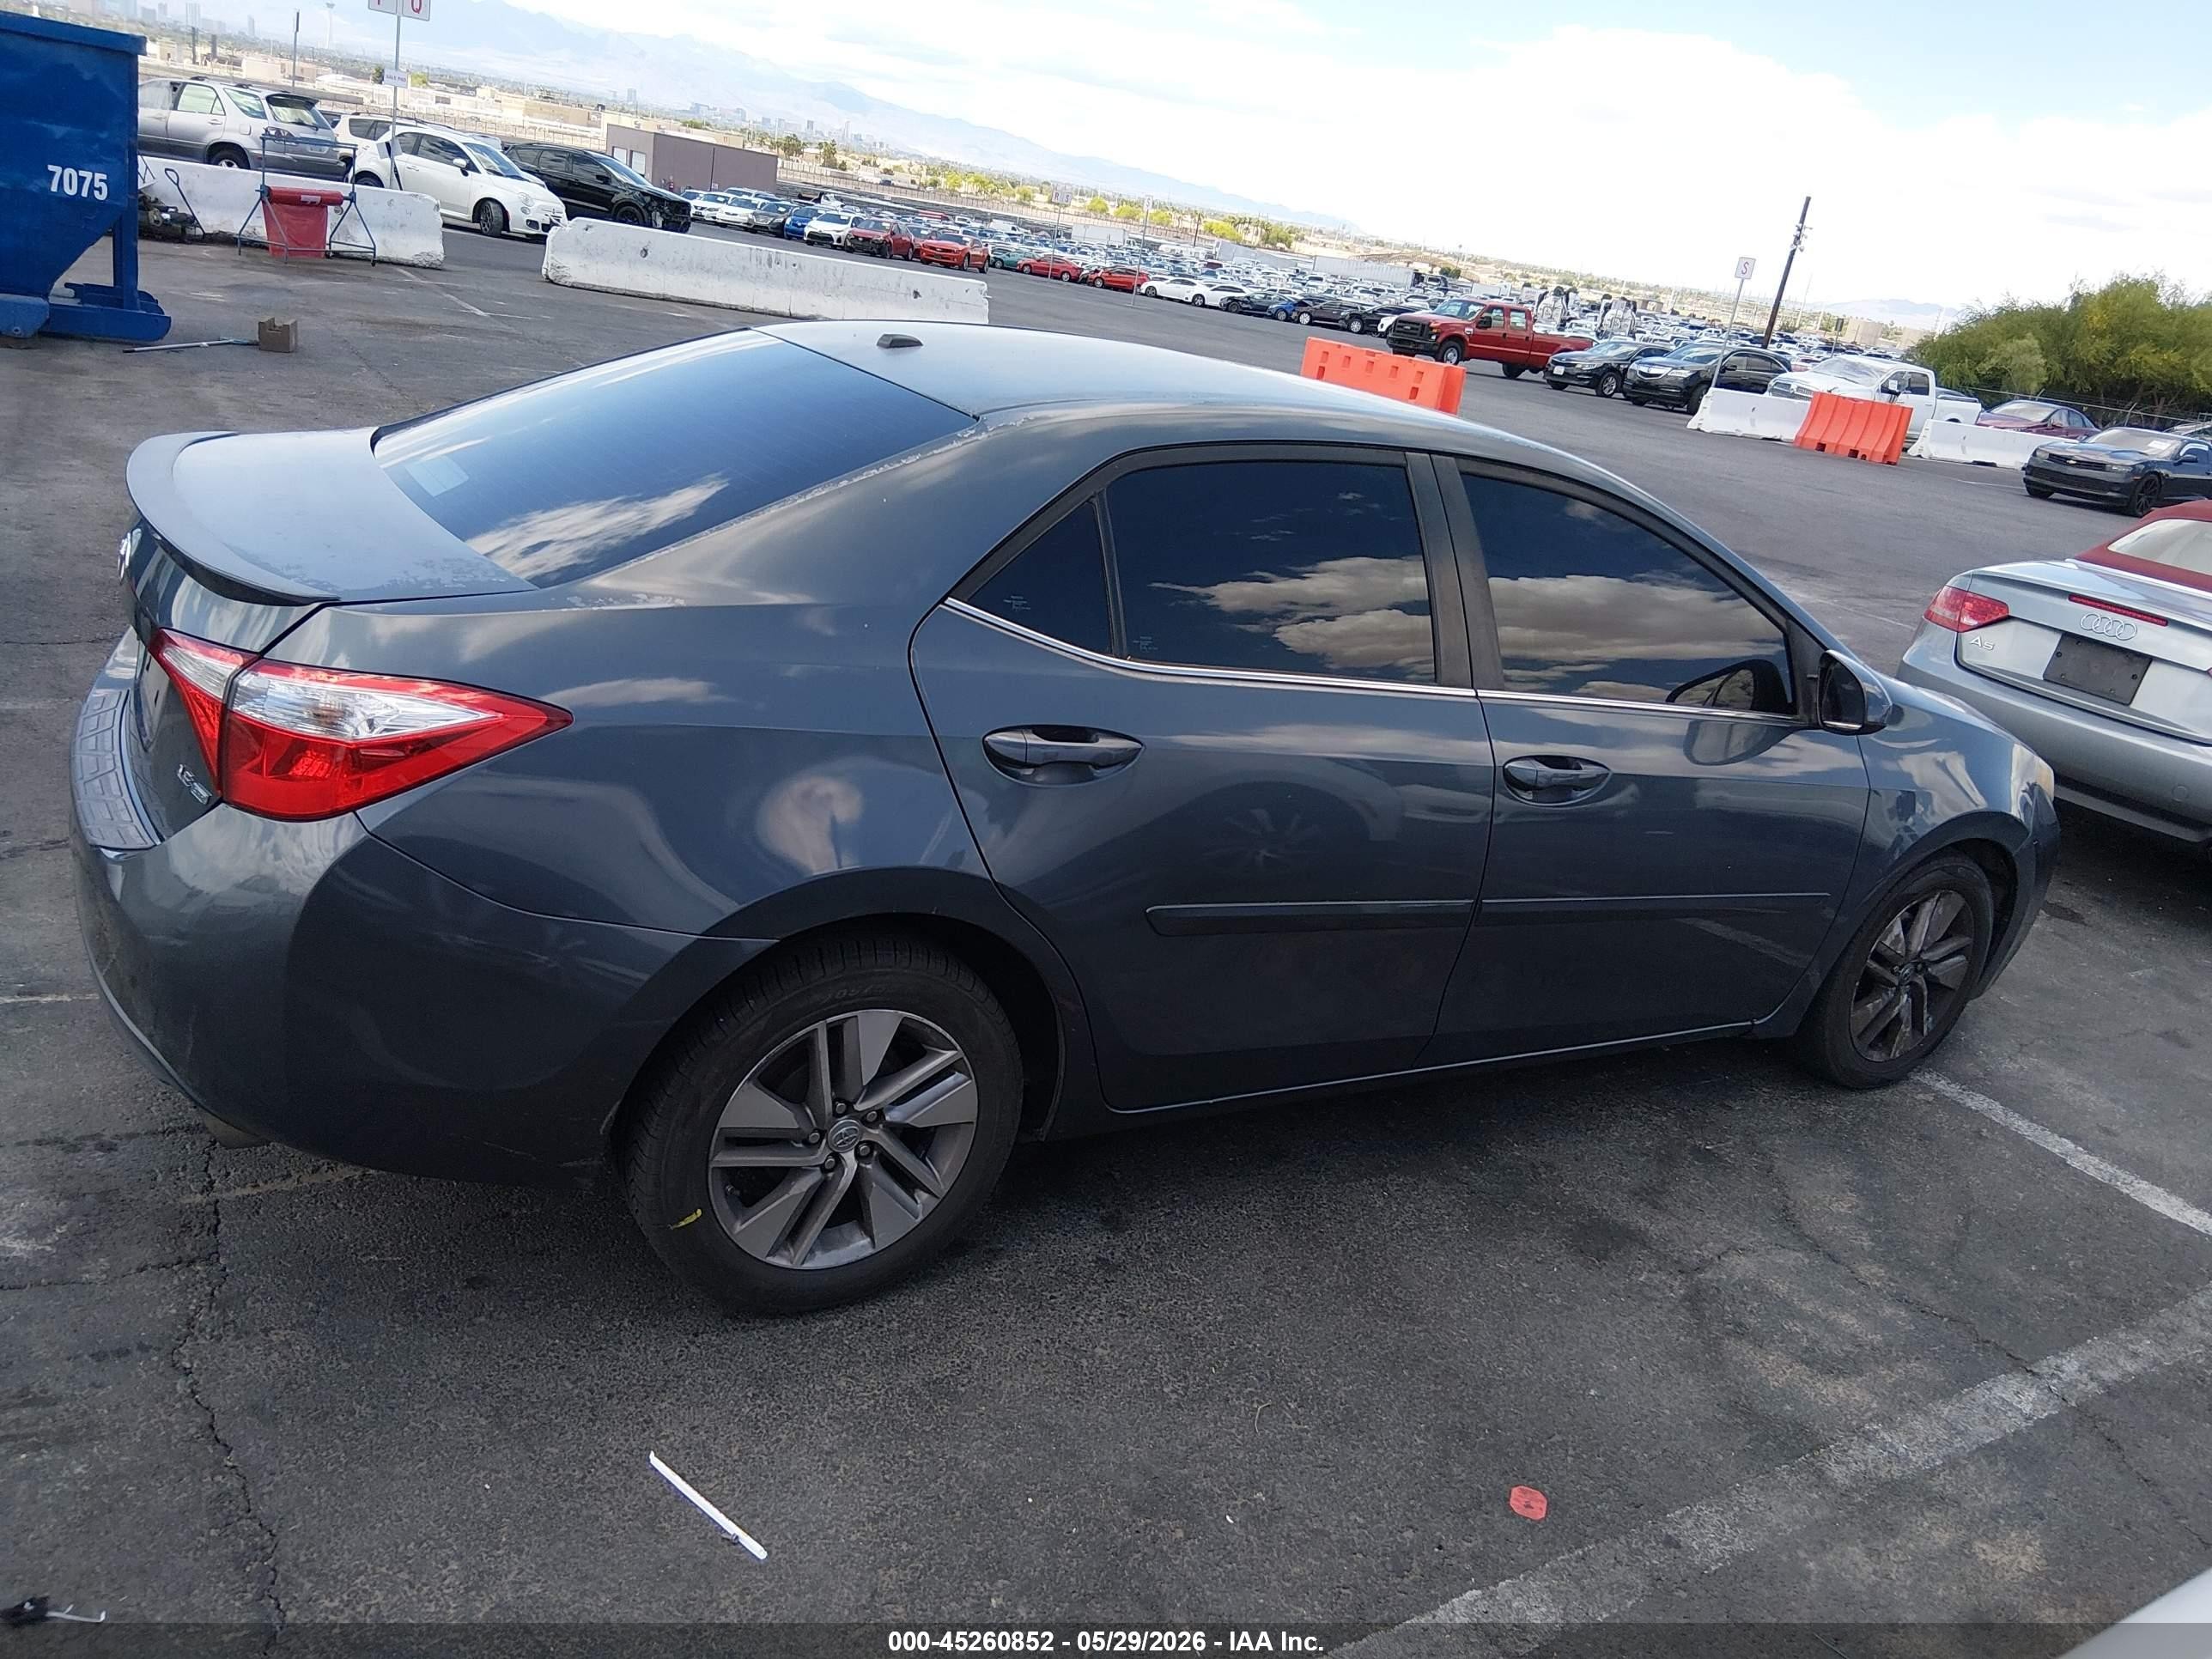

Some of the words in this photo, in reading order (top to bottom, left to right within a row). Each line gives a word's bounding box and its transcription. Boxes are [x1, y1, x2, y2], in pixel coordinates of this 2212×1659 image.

[47, 164, 108, 201] 7075
[1741, 261, 1750, 275] S
[1970, 635, 1996, 651] A5
